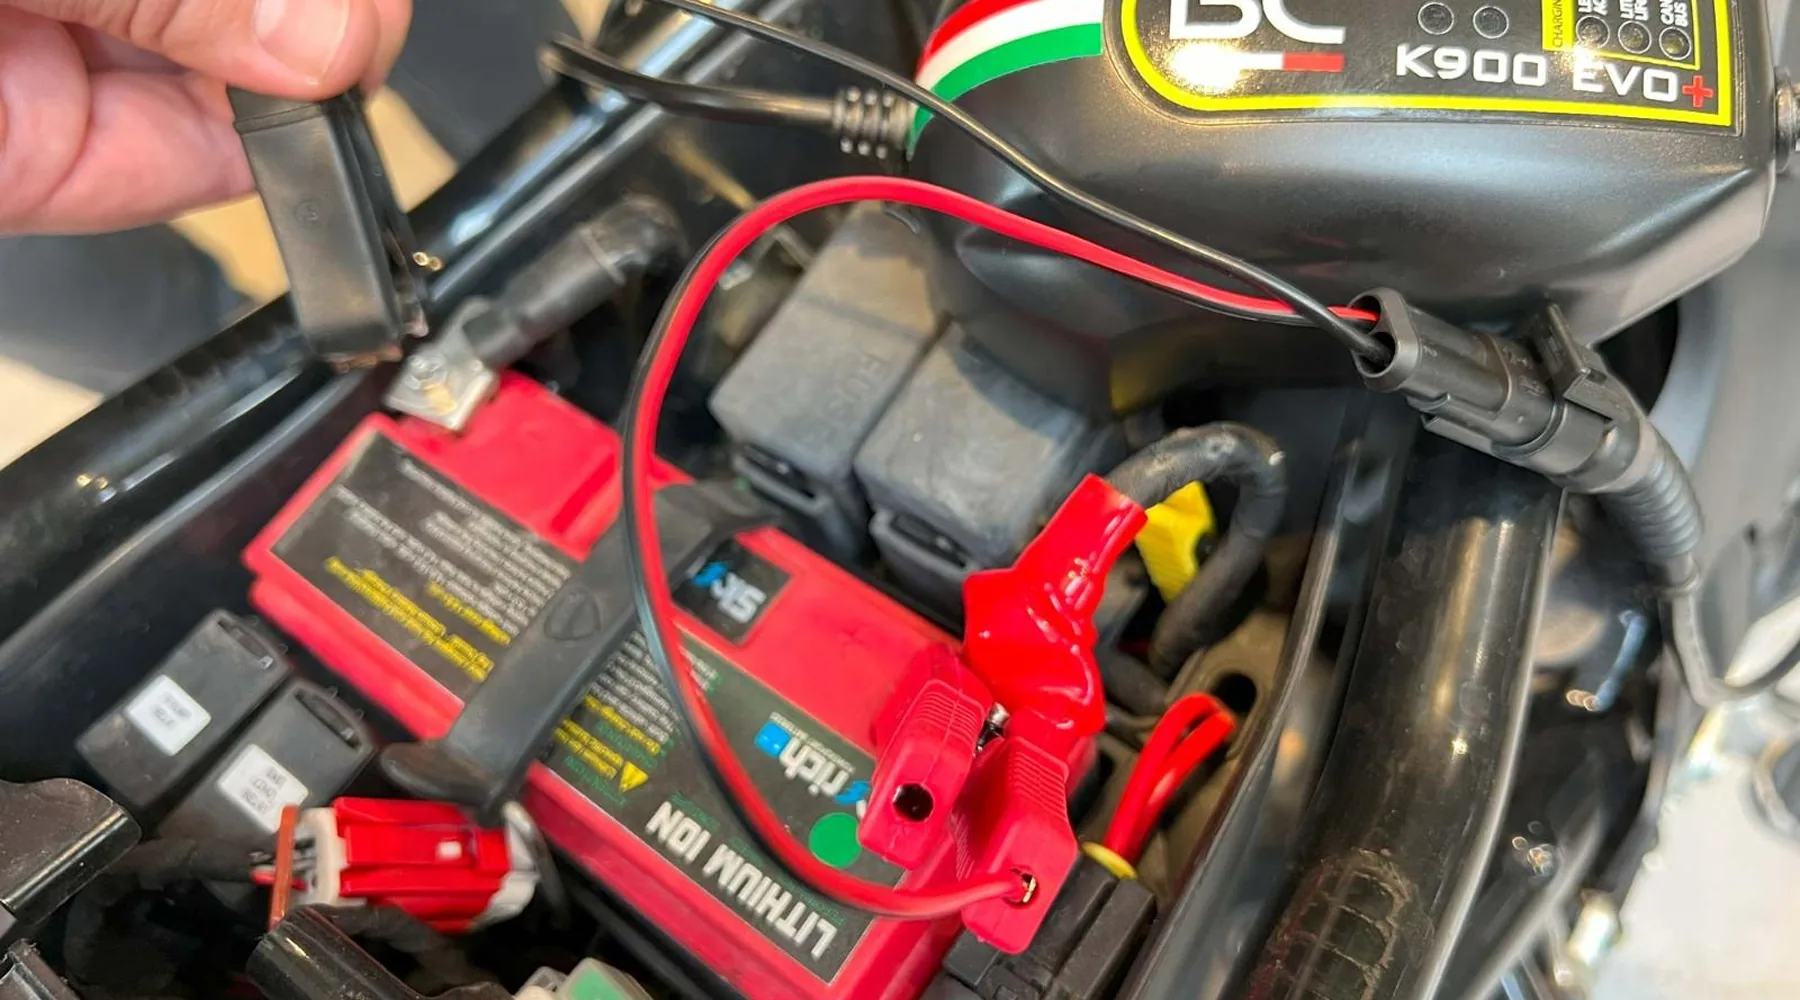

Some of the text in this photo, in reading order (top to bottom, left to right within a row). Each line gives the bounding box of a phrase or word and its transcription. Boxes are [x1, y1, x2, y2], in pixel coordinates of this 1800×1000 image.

[1673, 2, 1688, 27] BUS
[1396, 43, 1548, 87] K900
[645, 801, 712, 863] ION
[703, 843, 838, 960] LITHIUM
